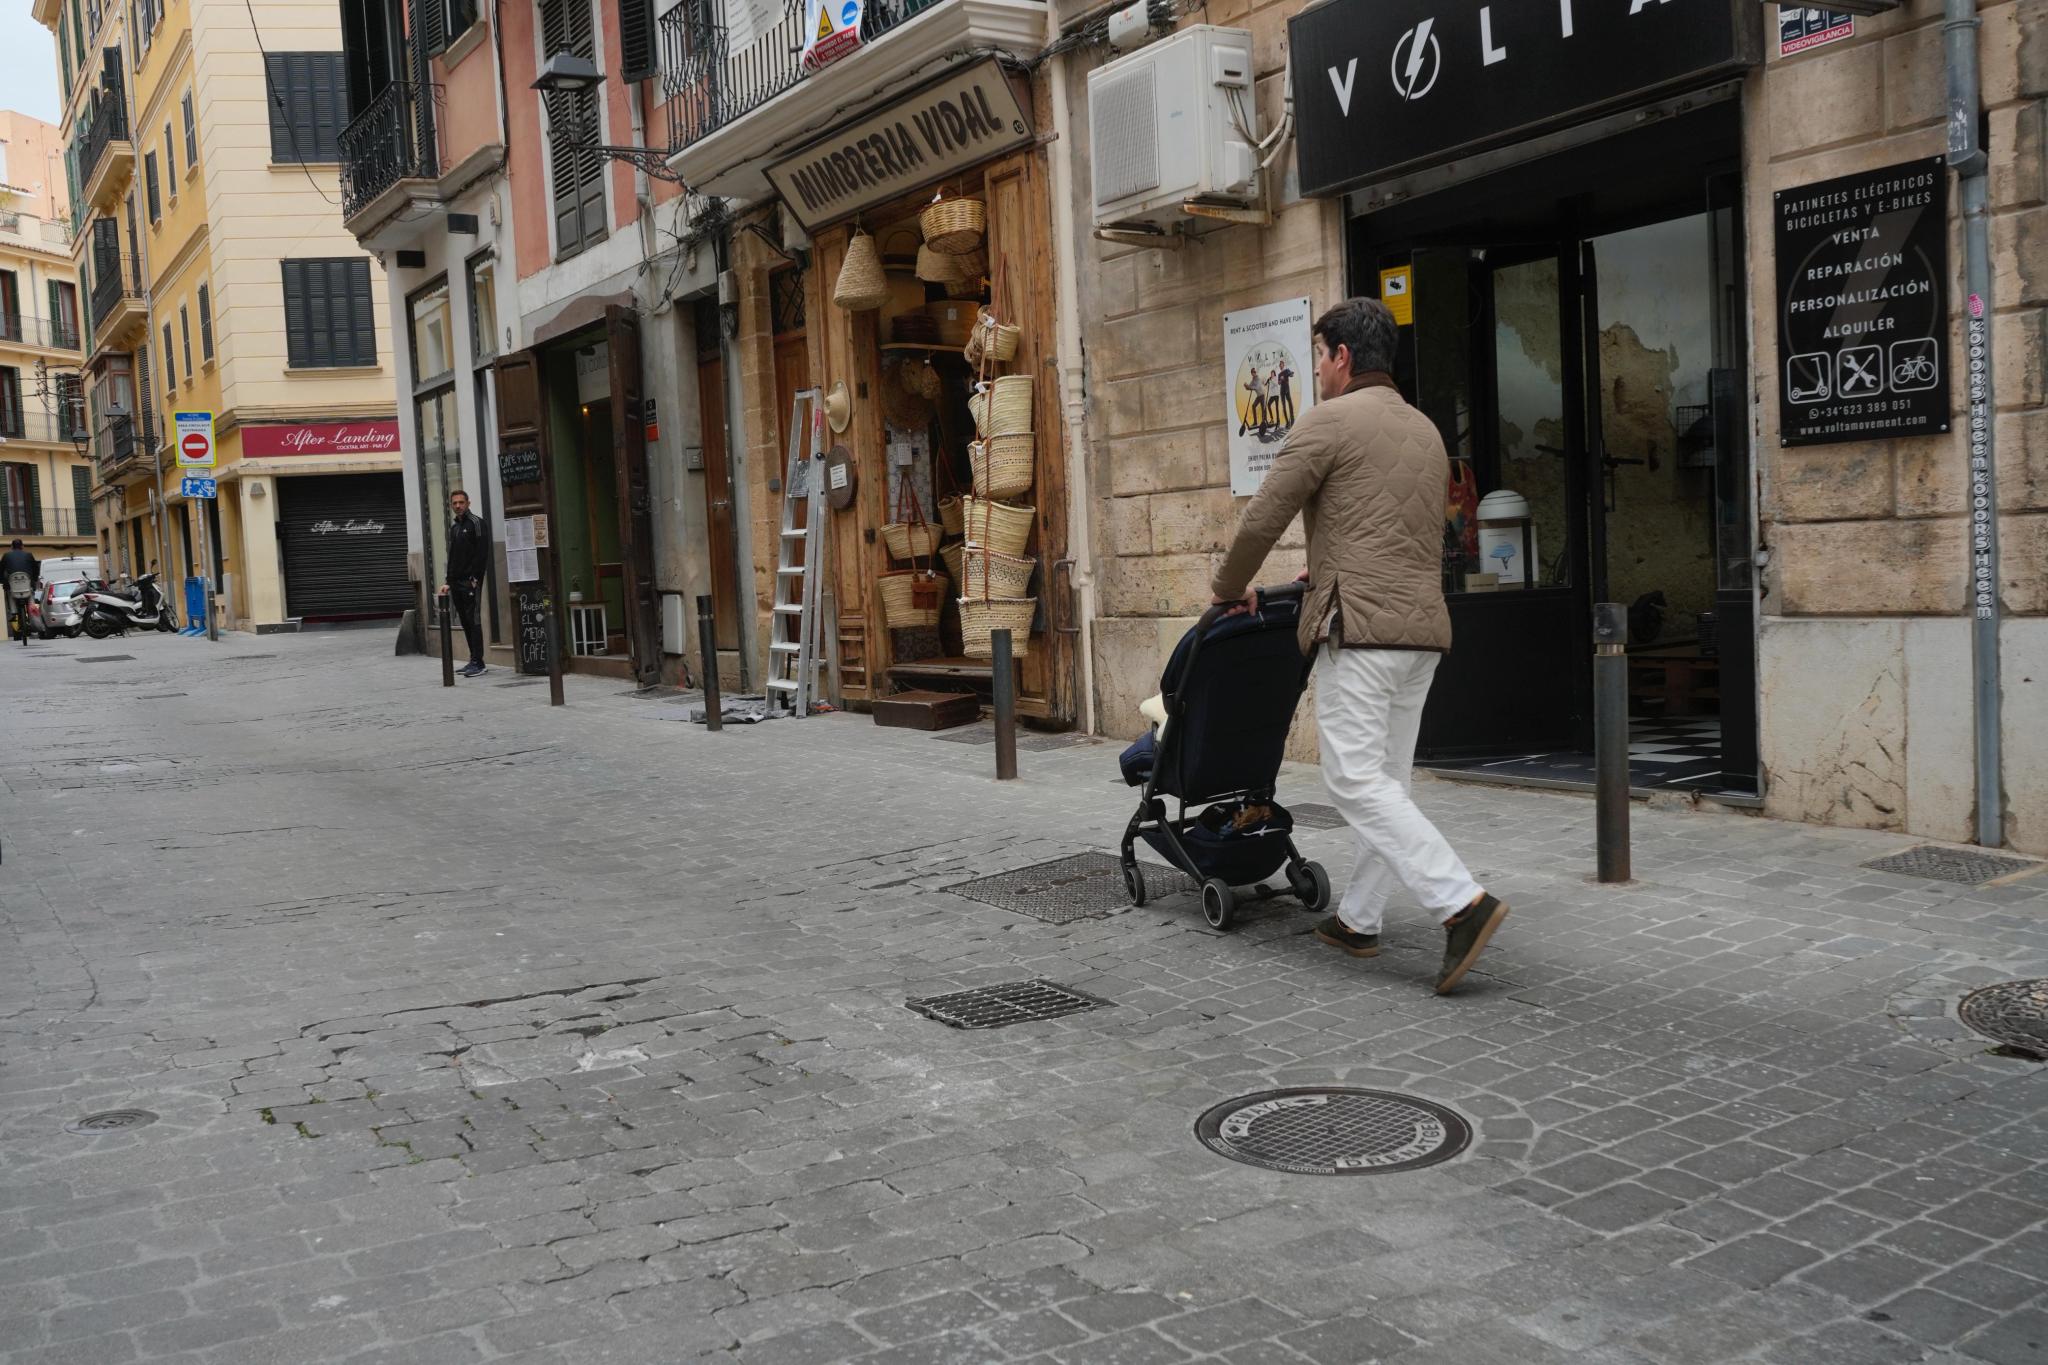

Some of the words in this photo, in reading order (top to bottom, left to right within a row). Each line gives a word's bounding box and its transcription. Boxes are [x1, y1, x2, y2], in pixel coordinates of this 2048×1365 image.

[1783, 26, 1851, 53] VIDEOVIGILANCIA
[789, 121, 925, 213] MIMBRERIA
[912, 85, 1002, 156] VIDAL
[1784, 191, 1848, 216] PATINETES
[1854, 172, 1934, 200] ELÉCTRICOS
[1786, 206, 1858, 231] BICICLETAS
[1864, 203, 1872, 215] Y
[1878, 191, 1932, 213] E-BIKES
[1832, 226, 1880, 245] VENTA
[1807, 252, 1903, 281] REPARACIÓN
[1790, 279, 1930, 313] PERSONALIZACIÓN
[1230, 327, 1241, 335] RENT
[1246, 321, 1268, 332] SCOOTER
[1268, 319, 1279, 327] AND
[1279, 316, 1292, 325] HAVE
[1823, 317, 1895, 339] ALQUILER
[1867, 401, 1887, 413] 389
[1800, 415, 1927, 435] www.voltamovement.com
[281, 428, 325, 451] After
[327, 427, 395, 448] Landing
[311, 520, 341, 535] After
[522, 614, 533, 625] EL
[523, 626, 546, 643] MEJOR
[1345, 1123, 1440, 1167] DRENATGE
